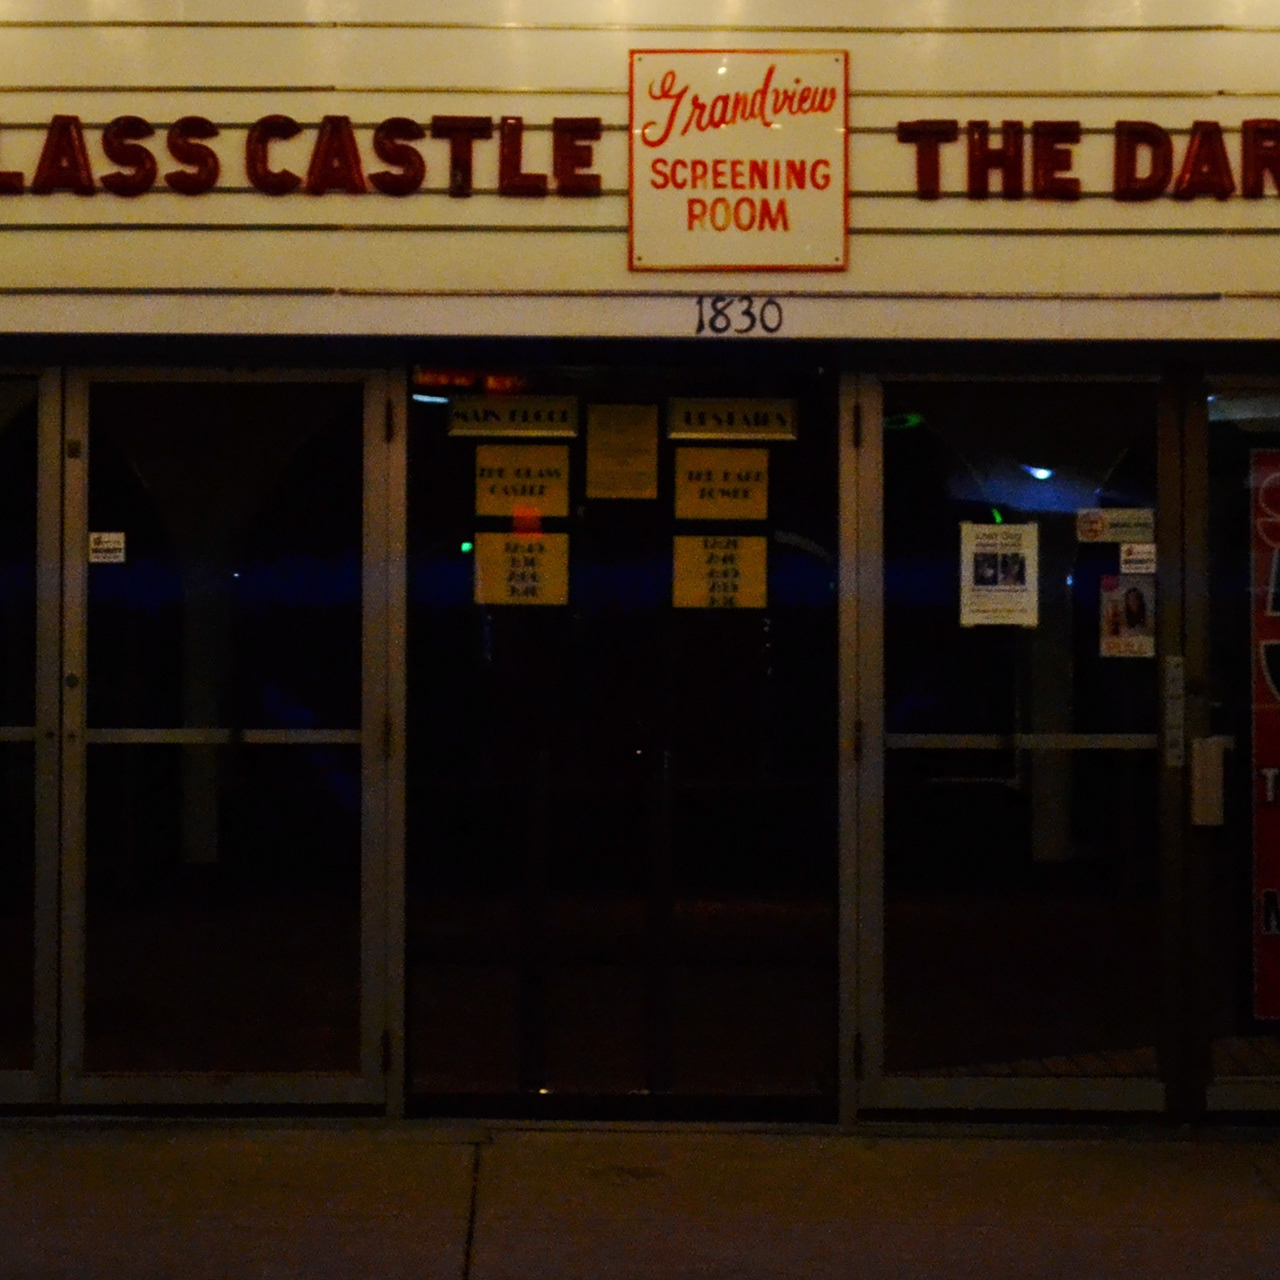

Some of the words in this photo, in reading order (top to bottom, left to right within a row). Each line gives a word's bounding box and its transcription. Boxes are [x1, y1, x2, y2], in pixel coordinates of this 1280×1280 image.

[641, 64, 837, 147] Grandview
[244, 114, 602, 198] CASTLE
[650, 157, 831, 190] SCREENING
[897, 119, 1081, 201] THE
[687, 197, 790, 232] ROOM
[695, 295, 783, 335] 1830
